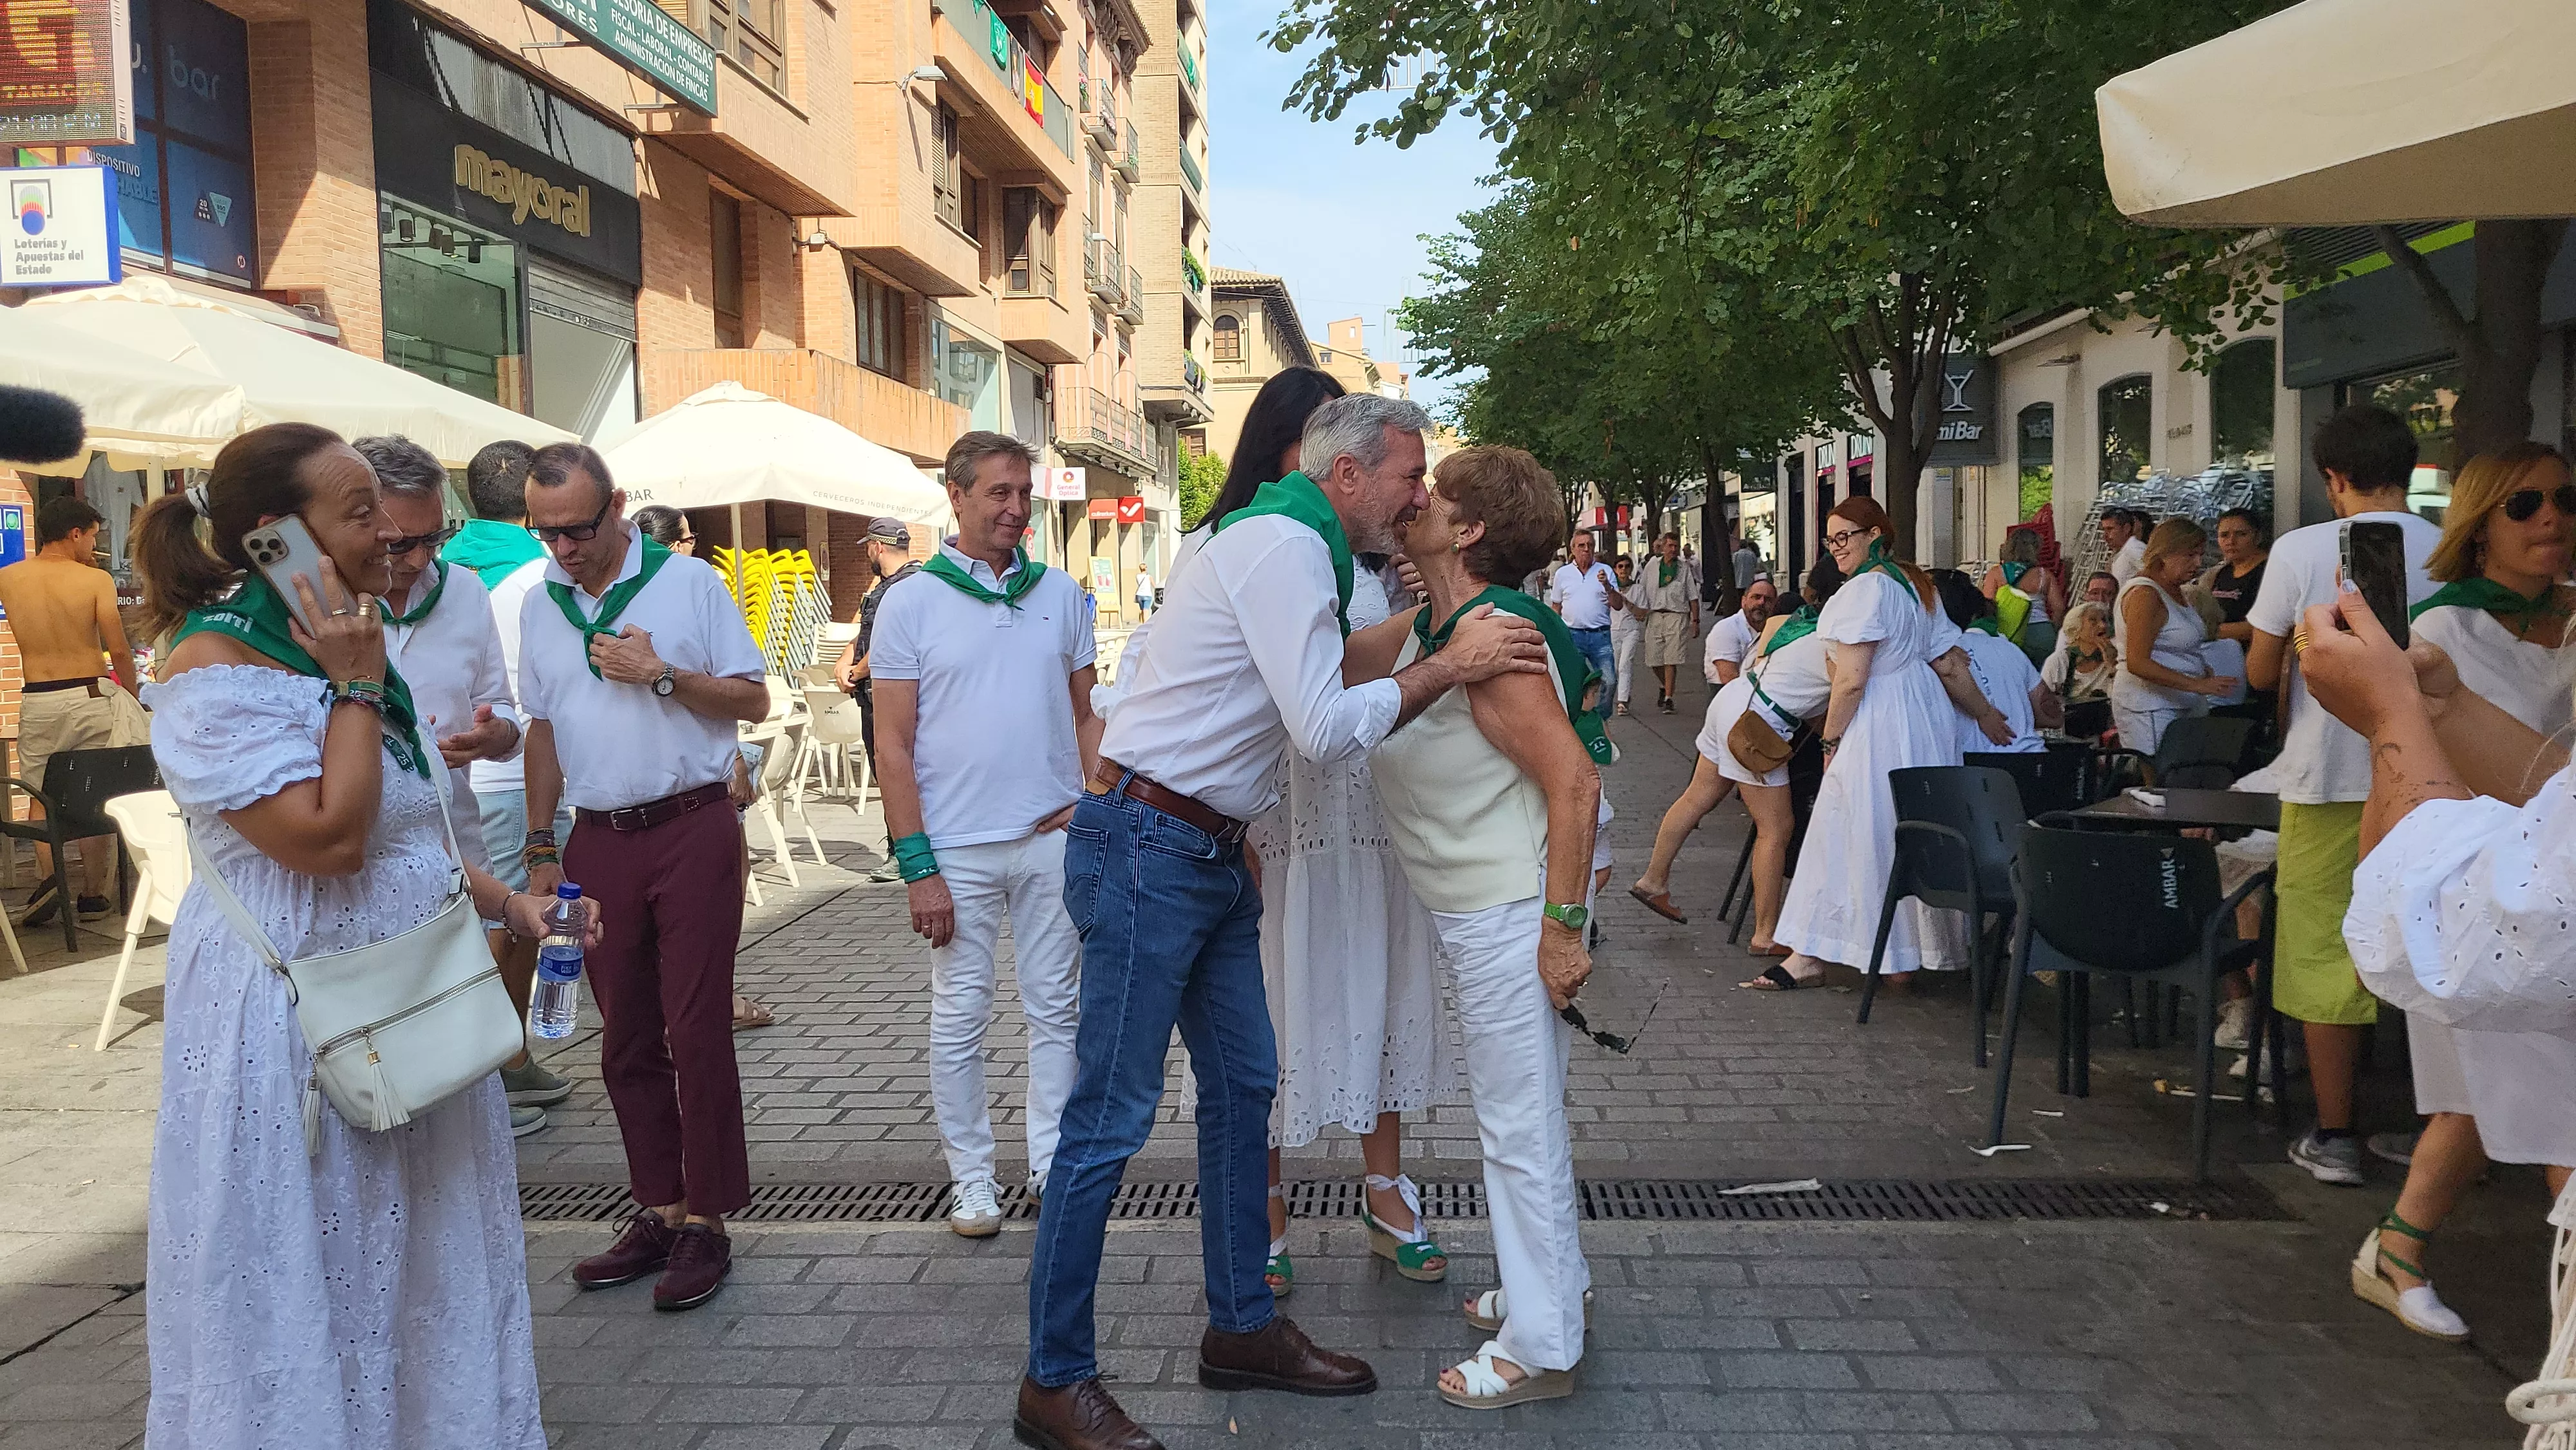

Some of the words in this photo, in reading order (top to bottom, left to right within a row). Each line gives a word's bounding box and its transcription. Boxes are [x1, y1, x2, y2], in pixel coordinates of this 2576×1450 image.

[611, 8, 637, 37] FISCAL
[641, 28, 673, 62] LABORAL
[677, 54, 709, 86] CONTABLE
[656, 14, 668, 39] DE
[670, 24, 713, 71] EMPRESAS
[169, 44, 220, 101] bar
[615, 30, 676, 82] ADMINISTRACION
[676, 70, 685, 86] DE
[685, 76, 708, 102] FINCAS
[86, 149, 140, 178] DISPOSITIVO
[200, 199, 207, 207] 20
[455, 144, 591, 237] mayoral
[14, 238, 58, 249] Loterías
[61, 240, 67, 250] y
[15, 250, 65, 264] Apuestas
[68, 249, 84, 261] del
[15, 263, 53, 275] Estado
[813, 491, 864, 505] CERVECEROS
[867, 500, 933, 516] INDEPENDIENTES
[117, 596, 135, 605] RIO:
[397, 753, 410, 766] 25
[2161, 858, 2178, 909] AMBAR
